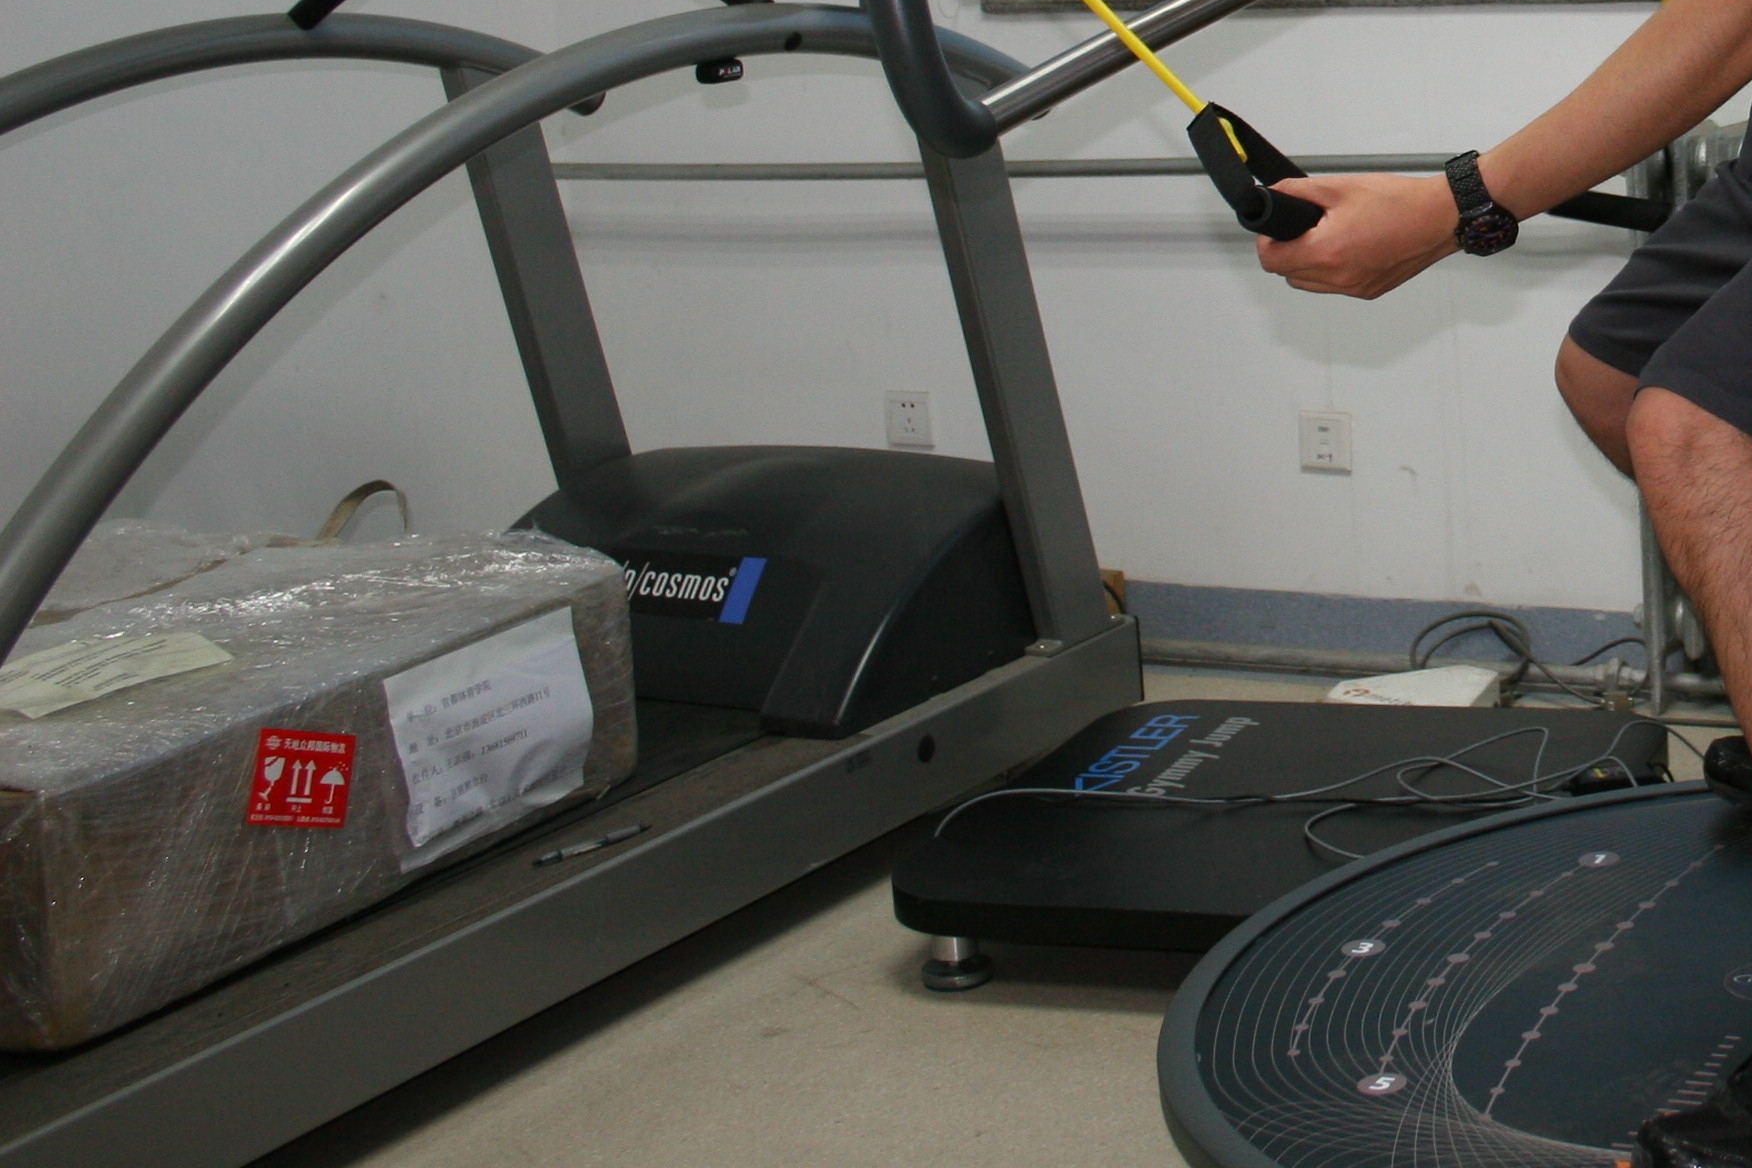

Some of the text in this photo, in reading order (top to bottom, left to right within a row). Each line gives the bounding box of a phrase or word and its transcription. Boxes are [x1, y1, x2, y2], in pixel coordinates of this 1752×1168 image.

[1190, 716, 1261, 748] Jump
[1593, 853, 1607, 865] 7
[1351, 942, 1374, 954] 3
[1368, 1076, 1396, 1091] 5
